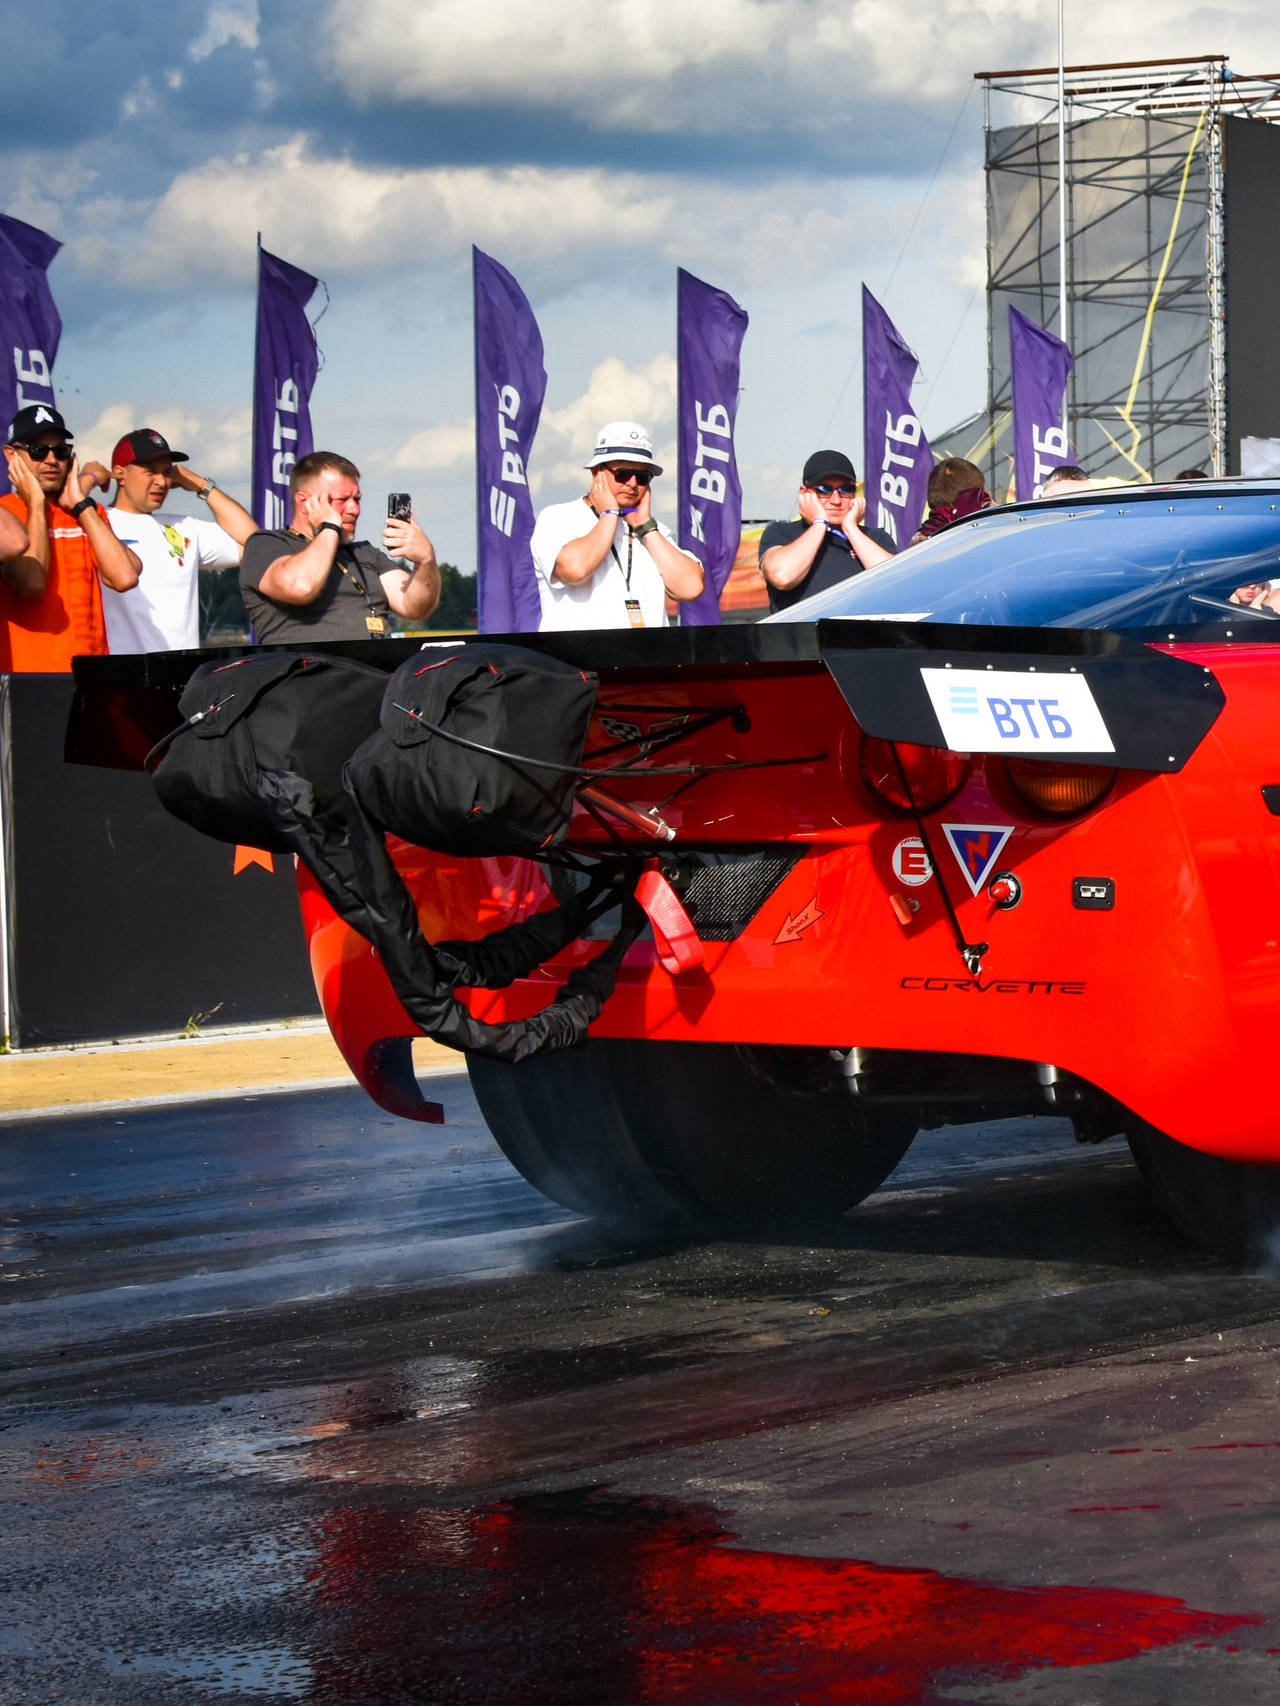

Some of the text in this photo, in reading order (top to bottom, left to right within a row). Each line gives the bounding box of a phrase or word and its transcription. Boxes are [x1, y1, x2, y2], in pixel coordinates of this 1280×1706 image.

[273, 378, 298, 486] ВТБ
[494, 382, 527, 486] ВТБ
[690, 400, 731, 504] ВТБ
[880, 409, 921, 507] ВТБ
[986, 697, 1073, 739] ВТБ
[901, 977, 1086, 995] CORVETTE
